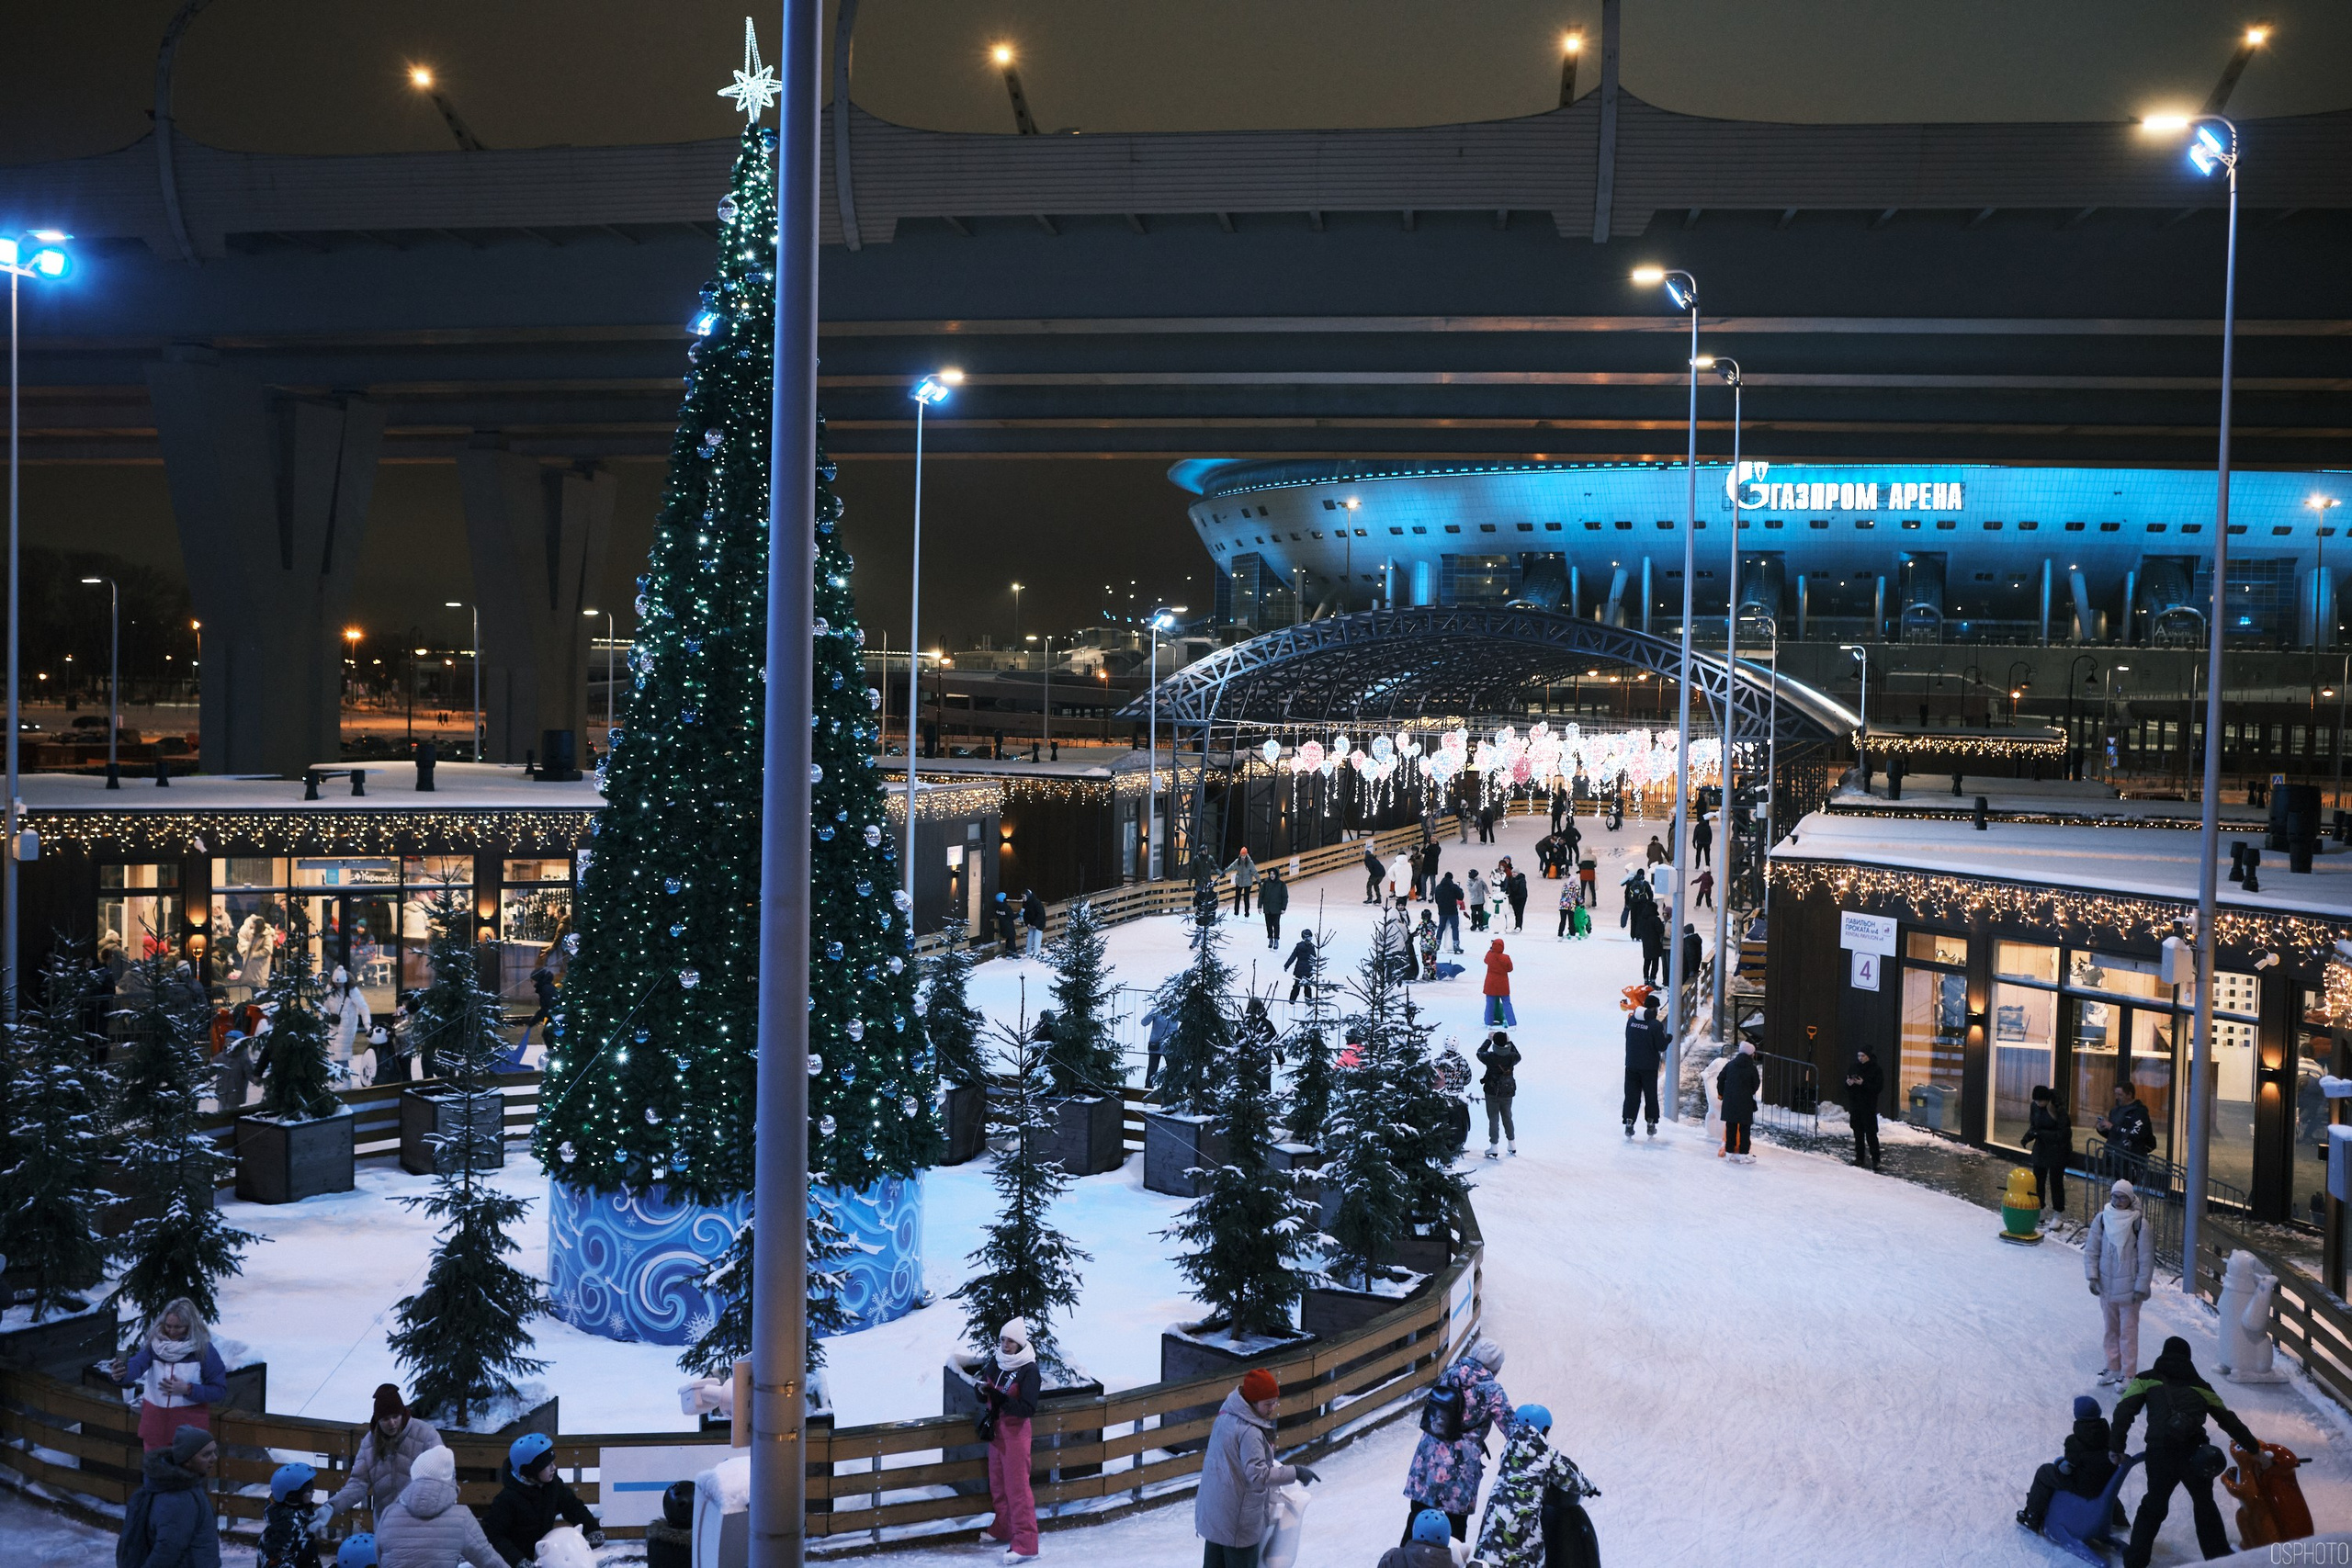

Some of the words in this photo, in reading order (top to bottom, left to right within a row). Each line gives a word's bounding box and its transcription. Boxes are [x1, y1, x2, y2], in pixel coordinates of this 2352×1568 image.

[1770, 482, 1878, 511] ГАЗПРОМ
[1888, 482, 1962, 511] АРЕНА
[1846, 918, 1875, 928] ПАВИЛЬОН
[1846, 924, 1870, 933] ПРОКАТА
[1860, 960, 1871, 981] 4
